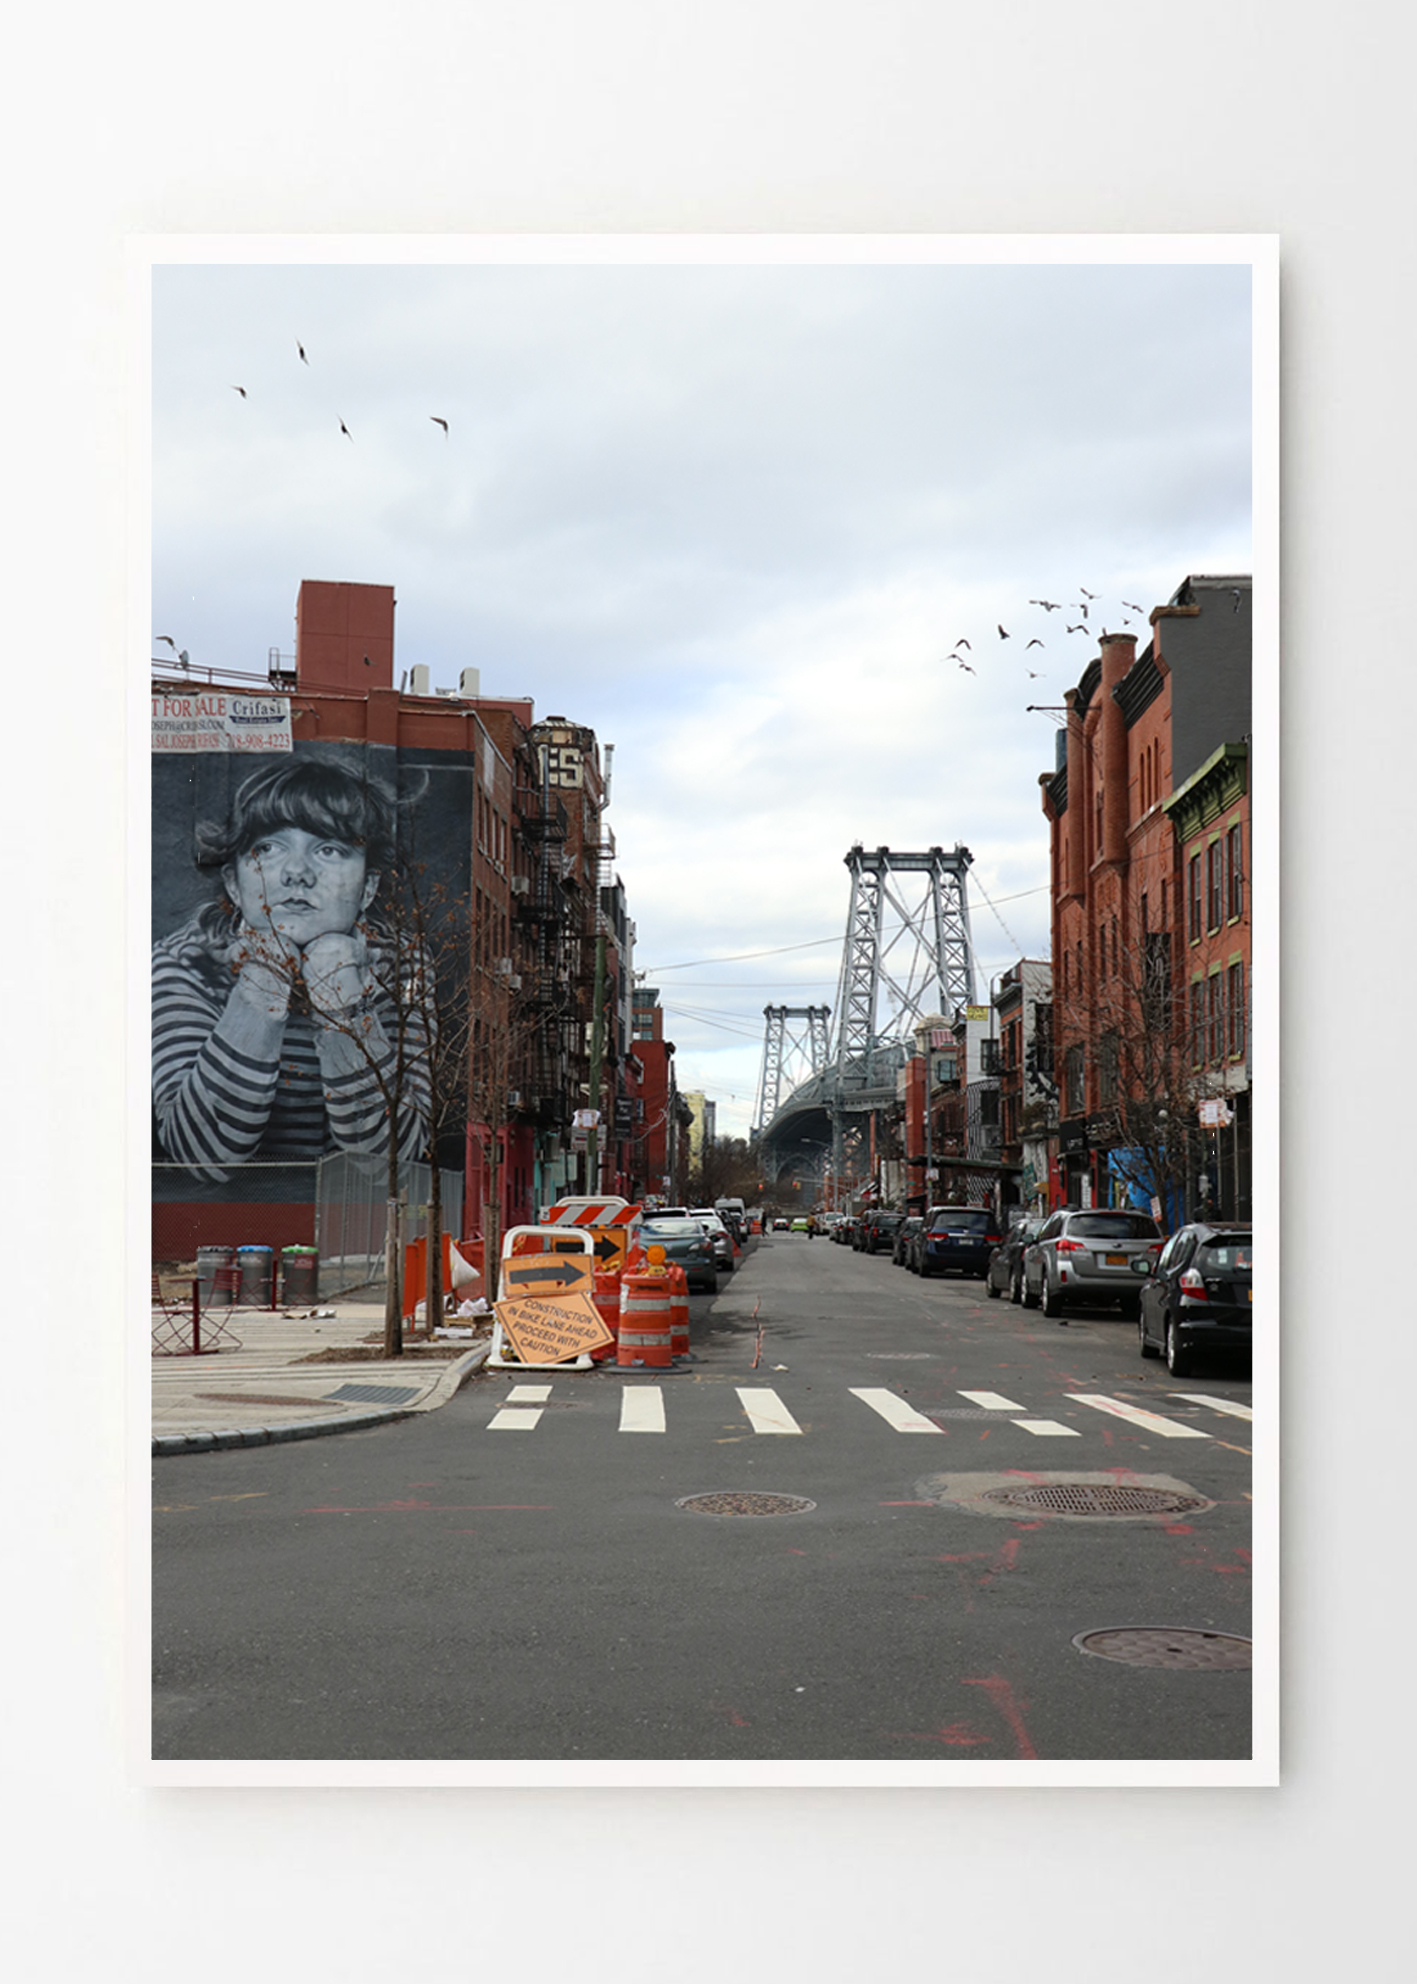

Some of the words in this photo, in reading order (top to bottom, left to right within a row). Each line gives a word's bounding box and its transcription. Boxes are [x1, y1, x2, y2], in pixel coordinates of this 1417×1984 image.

[163, 699, 193, 718] FOR
[195, 698, 227, 717] SALE
[232, 700, 282, 716] Crifasi
[507, 1305, 519, 1317] IN
[519, 1310, 539, 1324] BIKE
[541, 1316, 566, 1333] LANE
[565, 1323, 598, 1340] AHEAD
[524, 1299, 593, 1325] CONSTRUCTION
[512, 1321, 557, 1342] PROCEED
[557, 1334, 580, 1348] WITH
[520, 1337, 560, 1356] CAUTION
